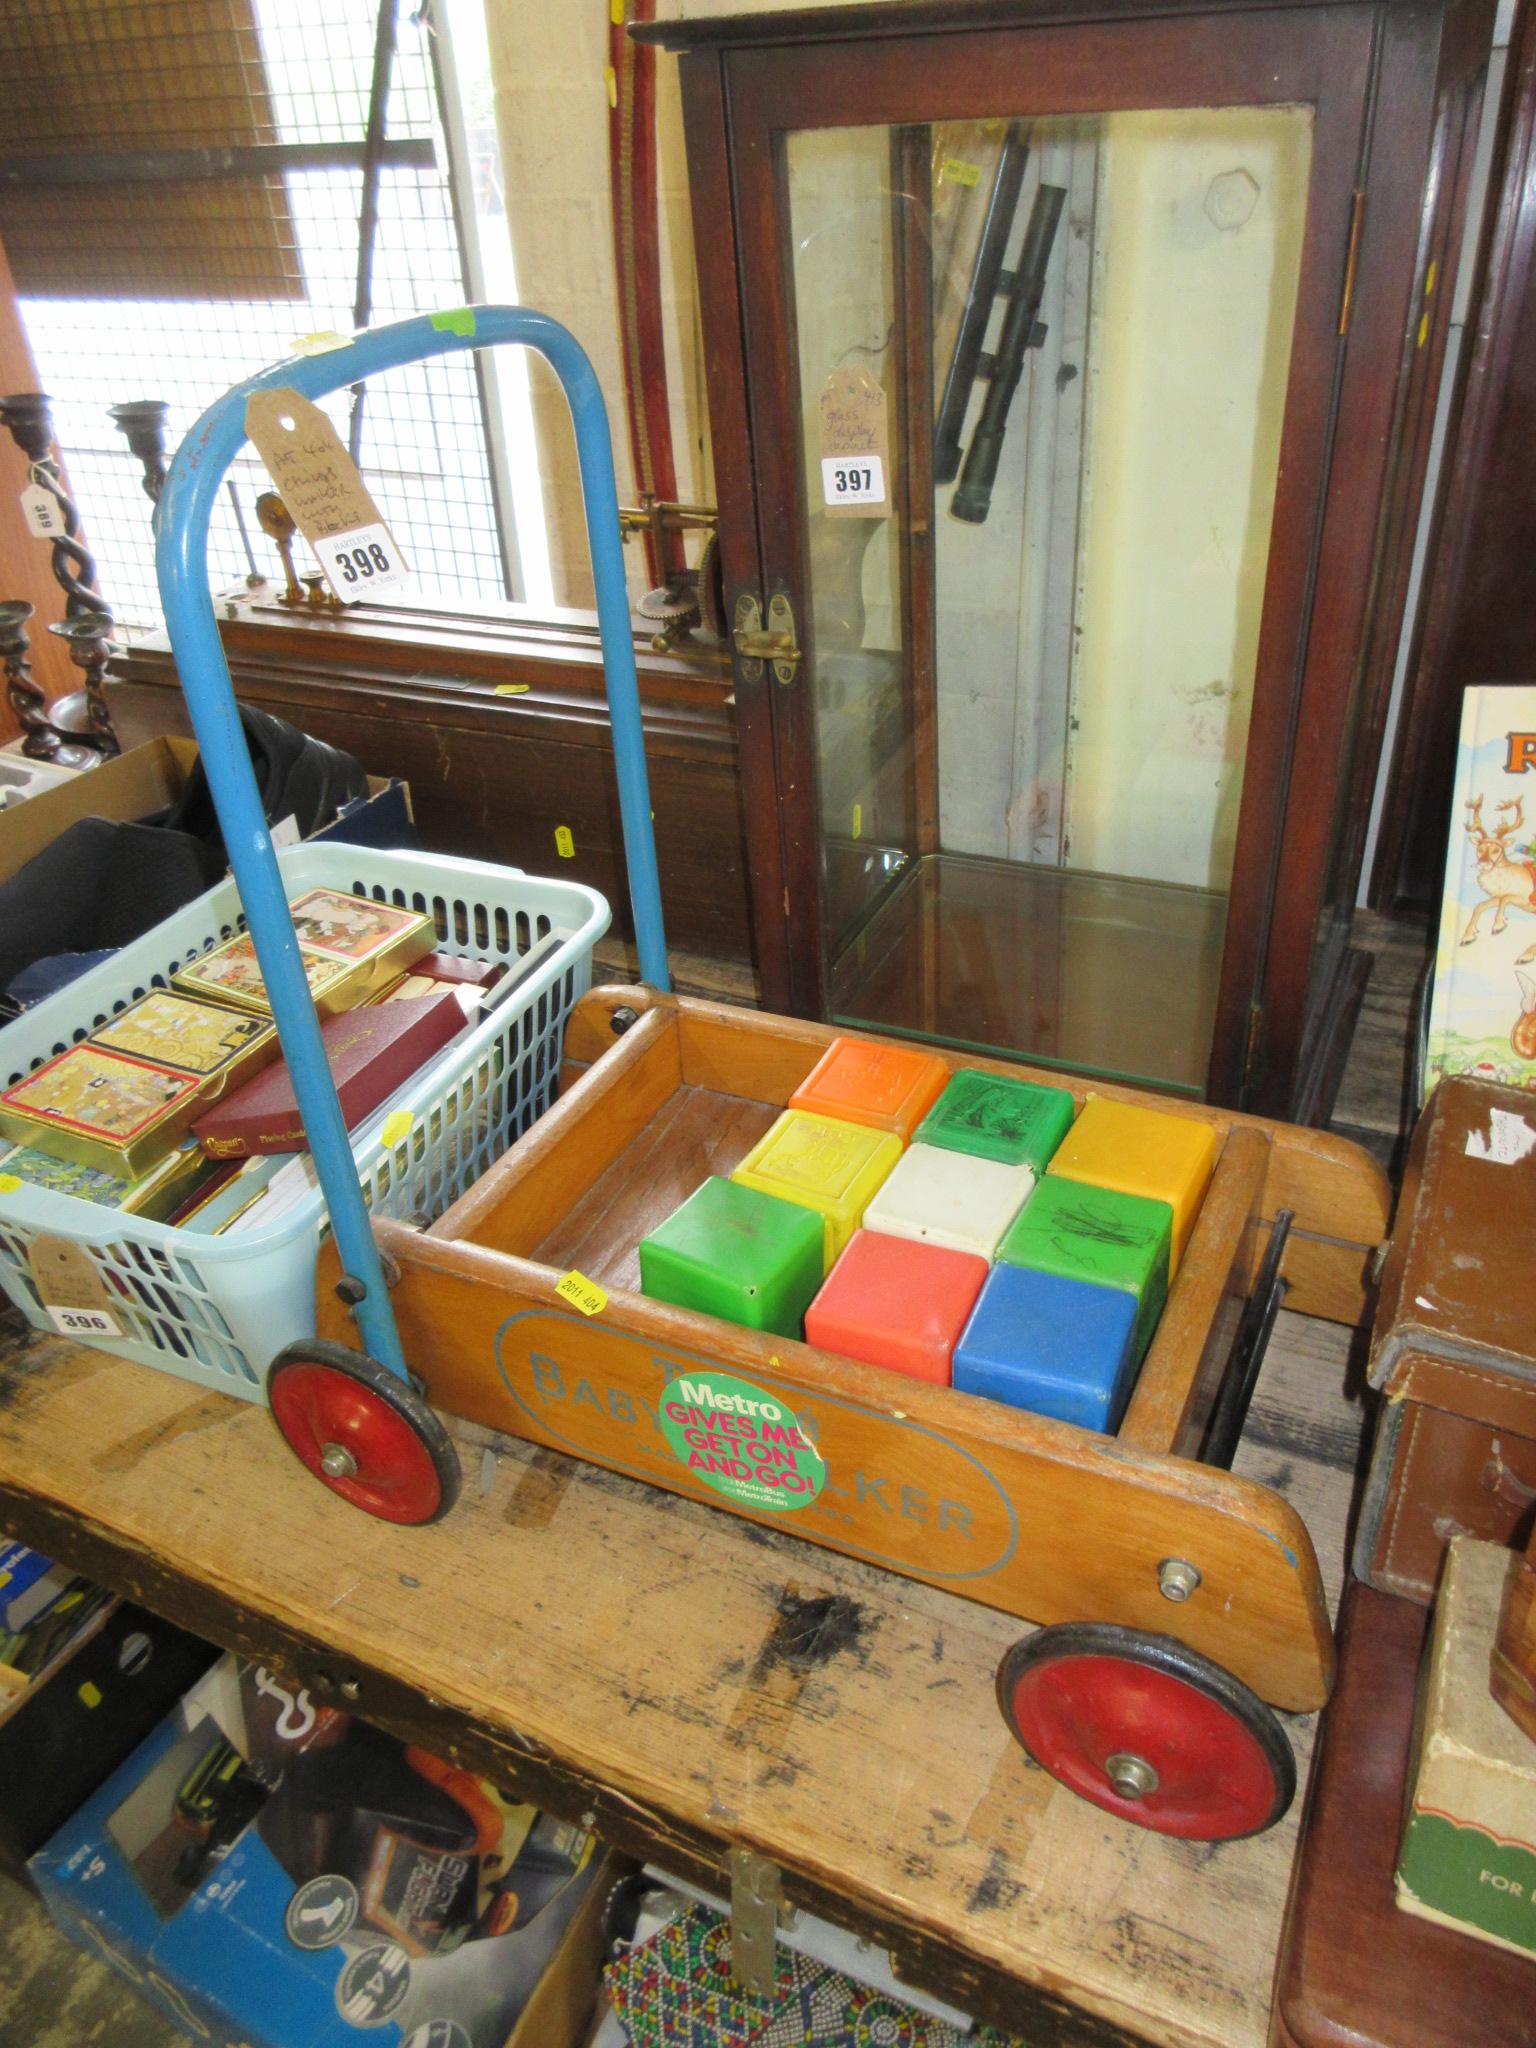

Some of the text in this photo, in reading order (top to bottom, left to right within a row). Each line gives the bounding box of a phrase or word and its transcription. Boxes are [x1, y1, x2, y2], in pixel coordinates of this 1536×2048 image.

[835, 470, 871, 492] 397
[336, 543, 390, 582] 398
[561, 1280, 601, 1311] 2011 404
[62, 1314, 107, 1329] 396
[679, 1380, 782, 1421] Metro
[665, 1402, 757, 1440] GIVES
[762, 1421, 810, 1451] ME
[684, 1428, 742, 1458] GET
[746, 1441, 798, 1471] ON
[688, 1451, 753, 1482] AND
[755, 1466, 817, 1497] GO!
[822, 1458, 976, 1541] LKER
[1480, 1869, 1523, 1897] FOR
